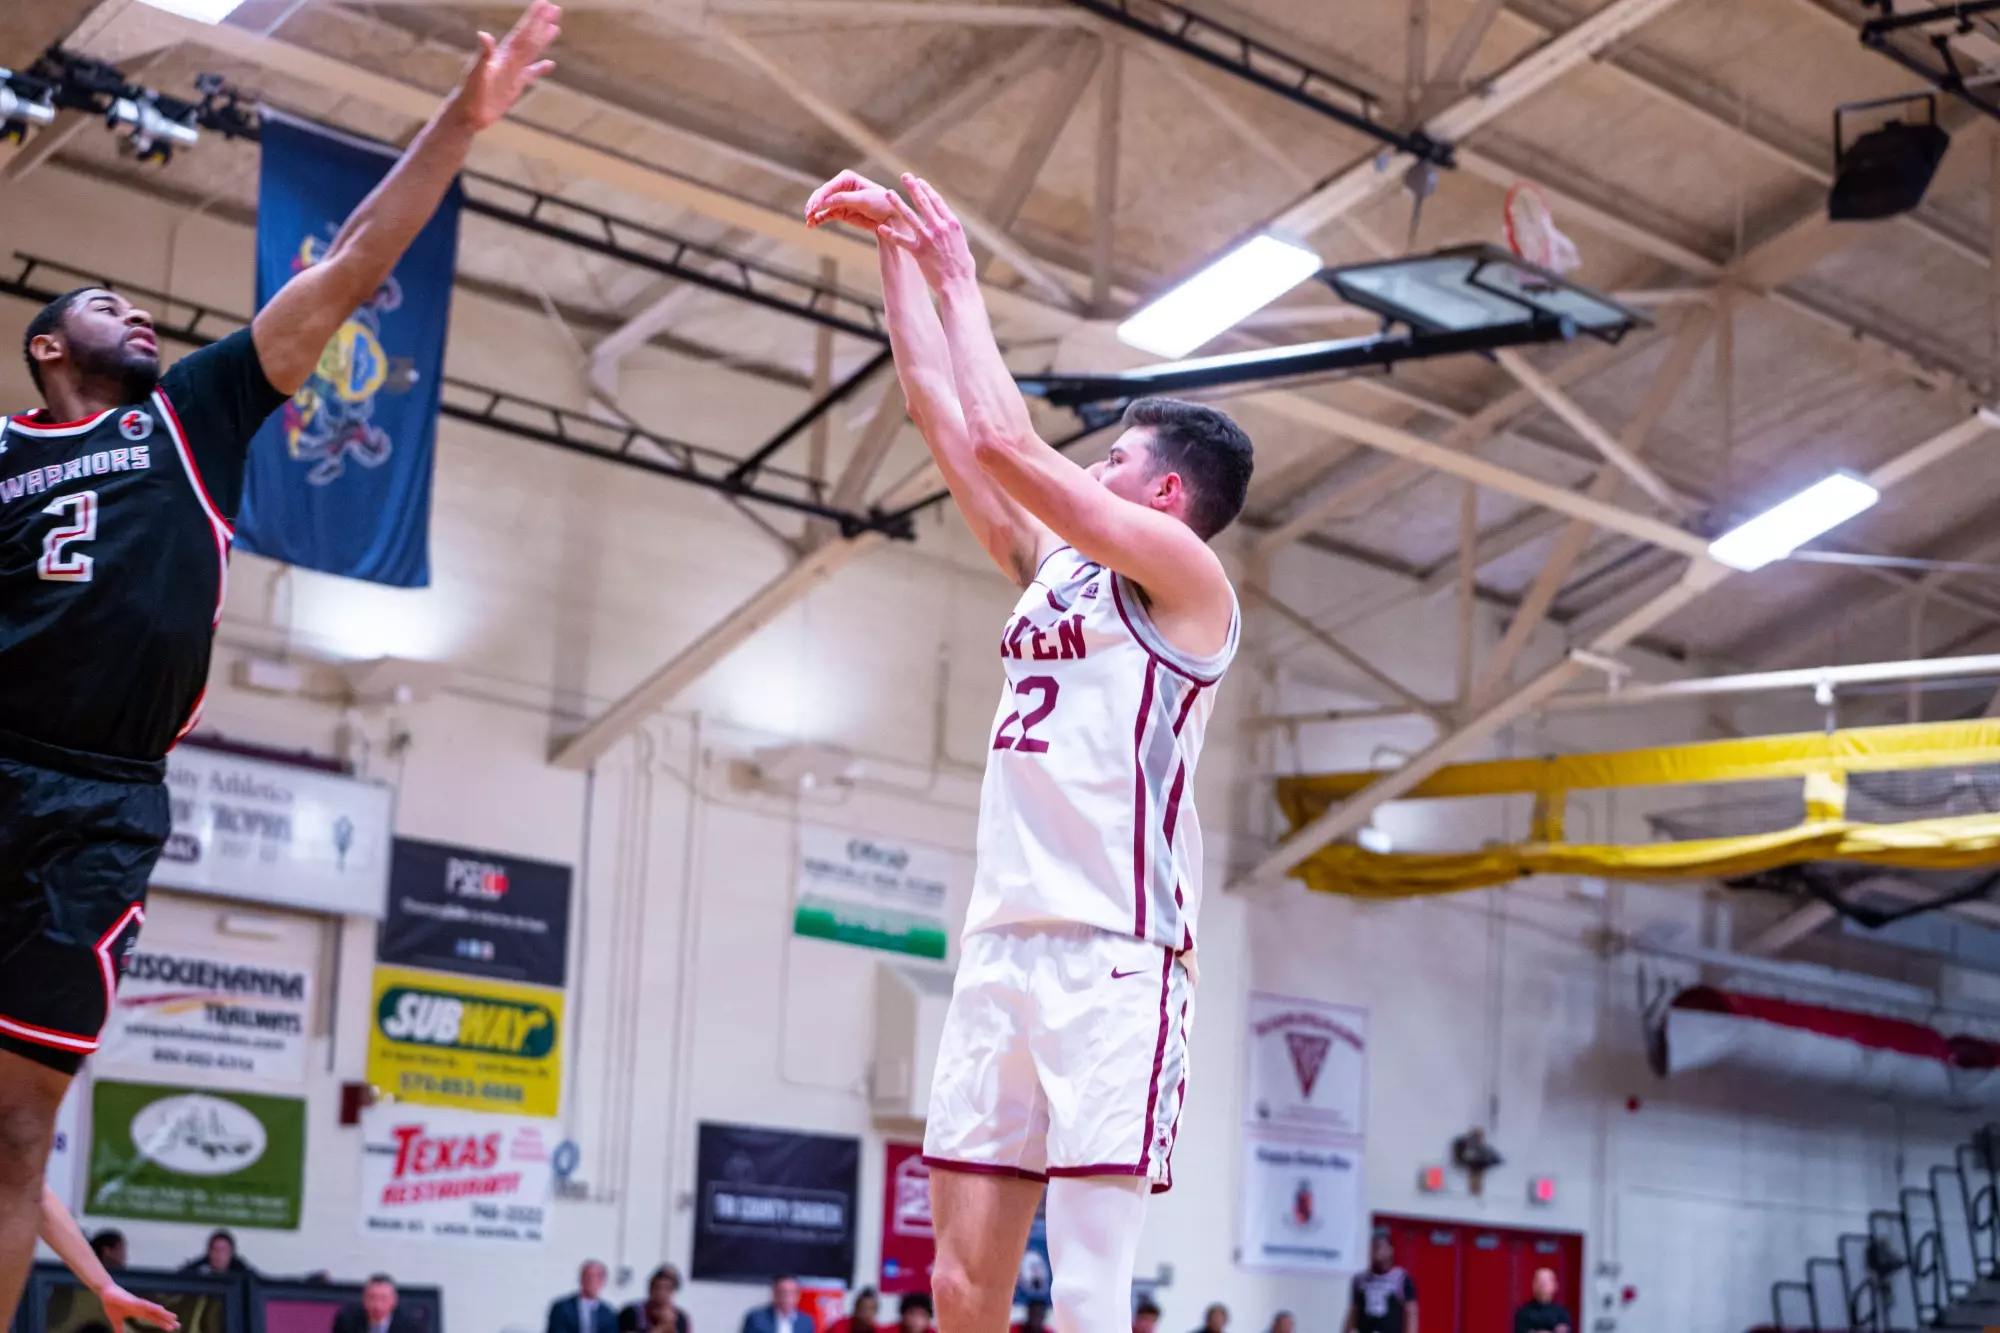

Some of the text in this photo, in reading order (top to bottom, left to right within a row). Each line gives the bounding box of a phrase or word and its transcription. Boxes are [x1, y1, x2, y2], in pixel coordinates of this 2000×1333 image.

[0, 445, 151, 504] WARRIORS
[37, 490, 98, 582] 2
[993, 676, 1060, 753] 22
[125, 952, 305, 998] USQUEHANNA
[384, 991, 548, 1051] SUBWAY
[391, 1122, 502, 1180] TEXAS
